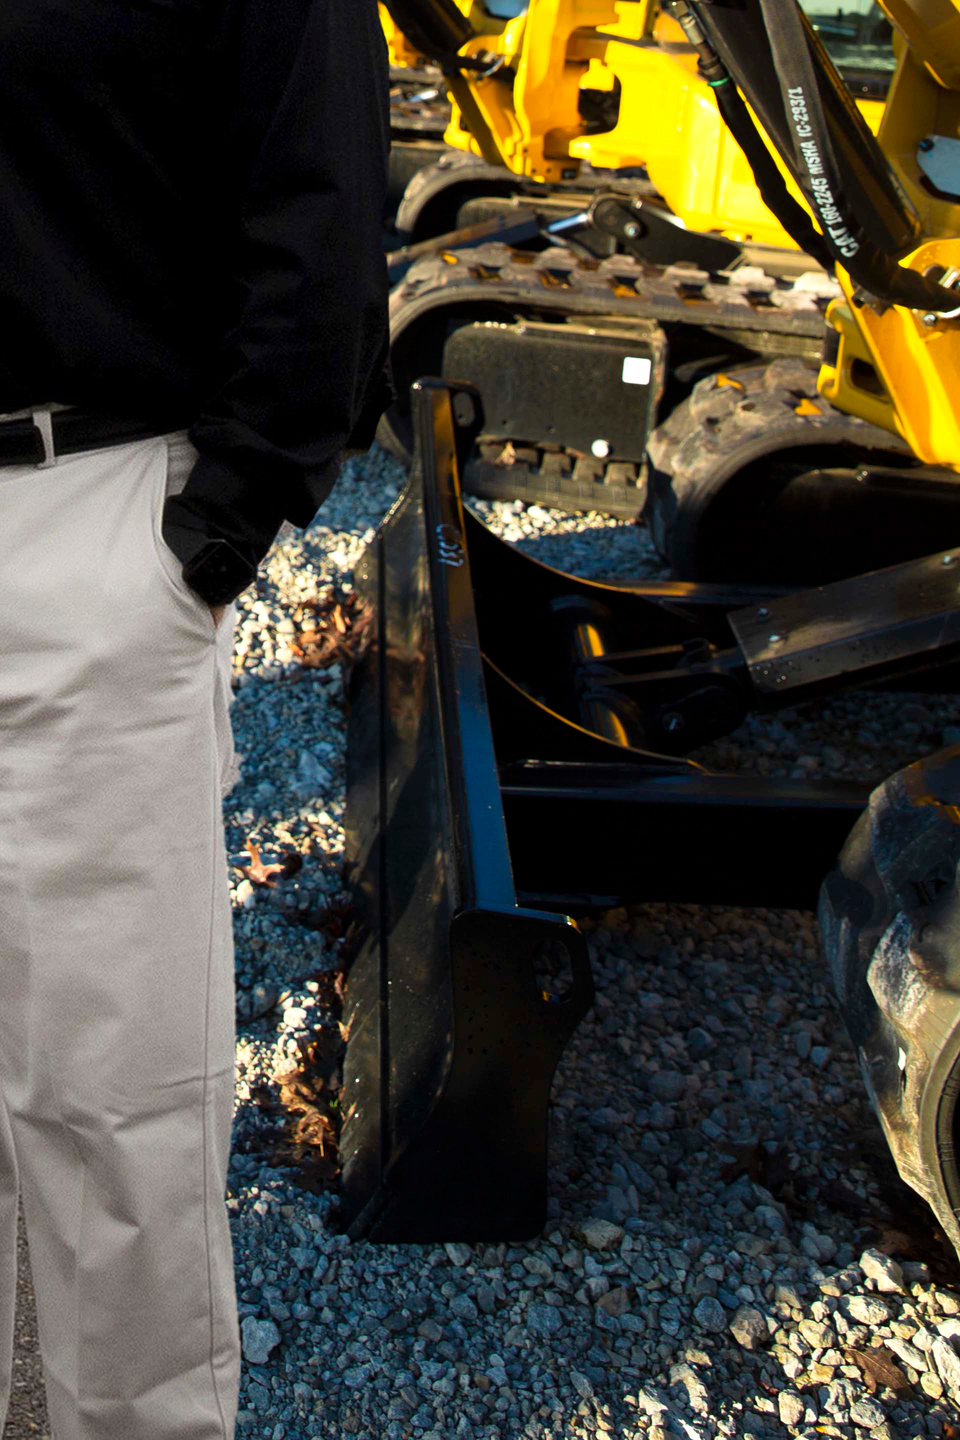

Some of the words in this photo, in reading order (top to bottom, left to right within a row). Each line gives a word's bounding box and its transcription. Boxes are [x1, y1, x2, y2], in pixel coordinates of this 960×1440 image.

[787, 86, 813, 137] IC-293/1
[800, 140, 825, 175] MSHA
[810, 177, 843, 226] 160-2245
[827, 227, 860, 258] CAT
